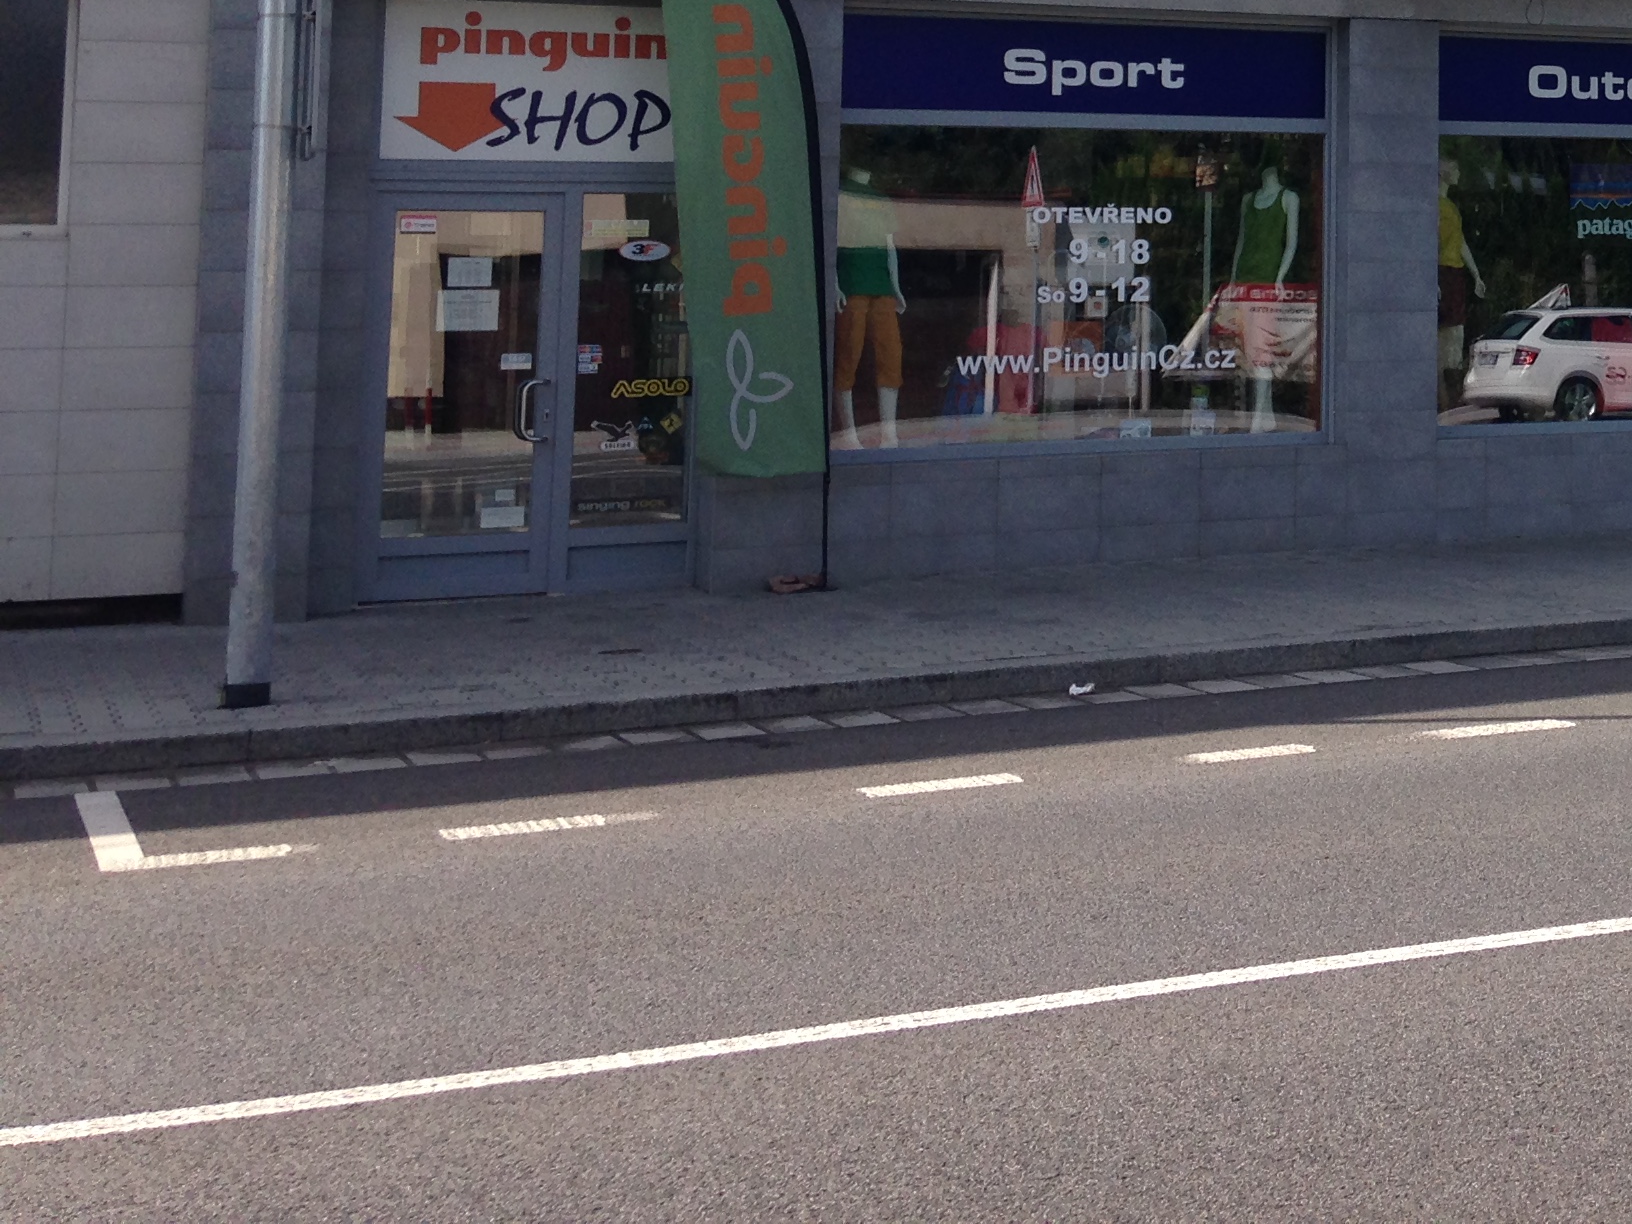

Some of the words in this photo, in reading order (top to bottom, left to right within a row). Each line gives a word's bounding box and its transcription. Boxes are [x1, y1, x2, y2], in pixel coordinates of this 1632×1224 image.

[419, 10, 668, 72] pinguin
[1003, 48, 1185, 96] Sport
[485, 86, 672, 152] SHOP
[1032, 202, 1173, 224] OTEVŘENO
[1069, 238, 1089, 264] 9
[1111, 238, 1151, 264] 18
[1068, 277, 1089, 303] 9
[1111, 277, 1151, 303] 12
[956, 343, 1237, 378] www.PinguinCz.cz
[611, 378, 690, 399] ASOLO
